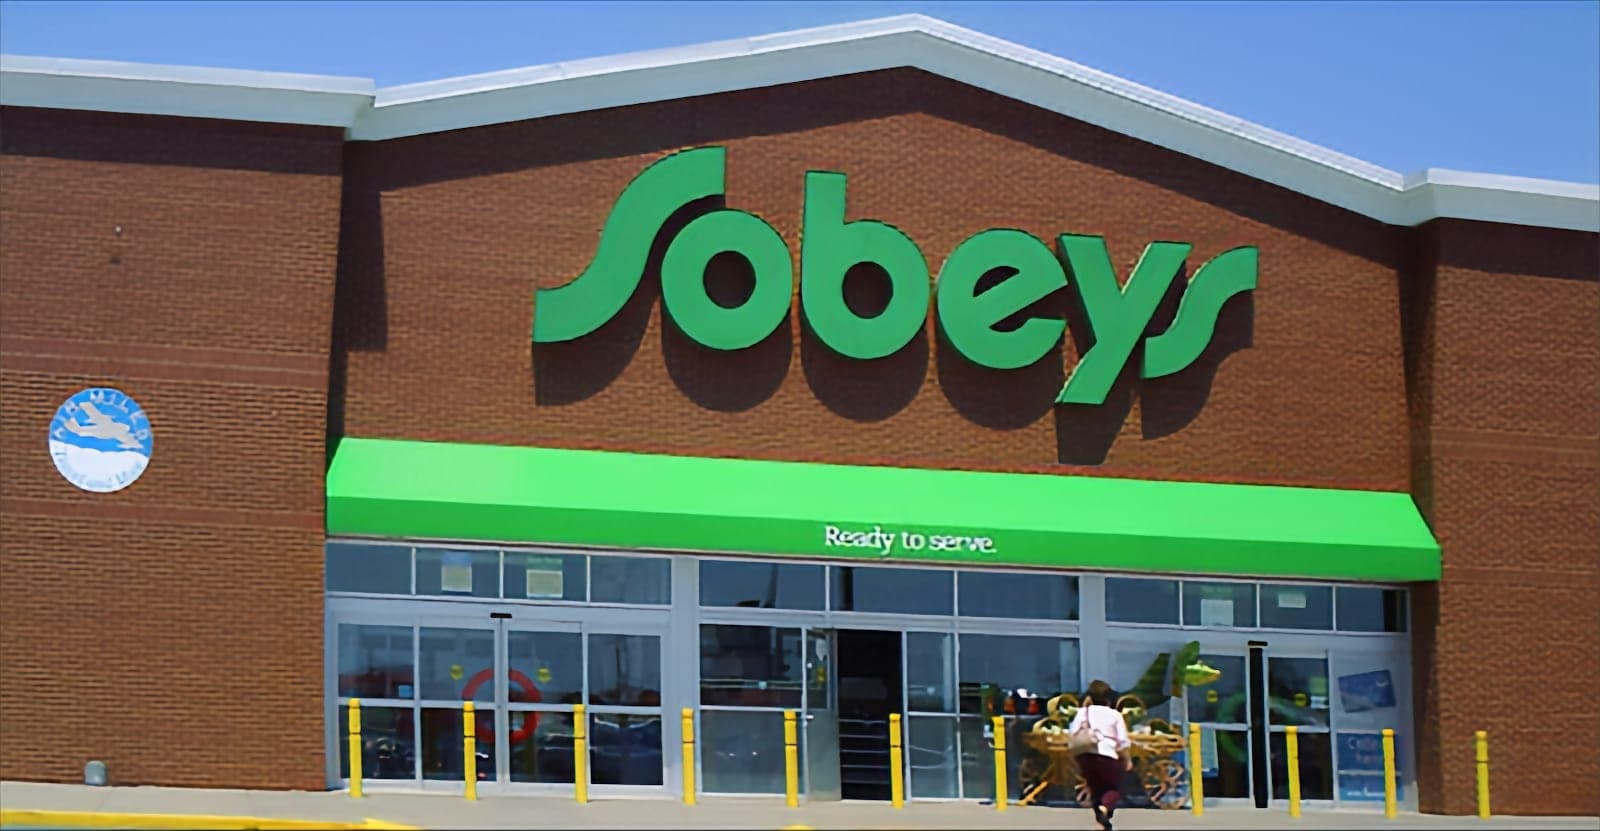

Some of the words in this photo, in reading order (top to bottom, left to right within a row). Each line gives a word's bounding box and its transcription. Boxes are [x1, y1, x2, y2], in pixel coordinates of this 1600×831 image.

[531, 145, 1259, 405] Sobeys
[824, 525, 896, 555] Ready
[901, 531, 926, 550] to
